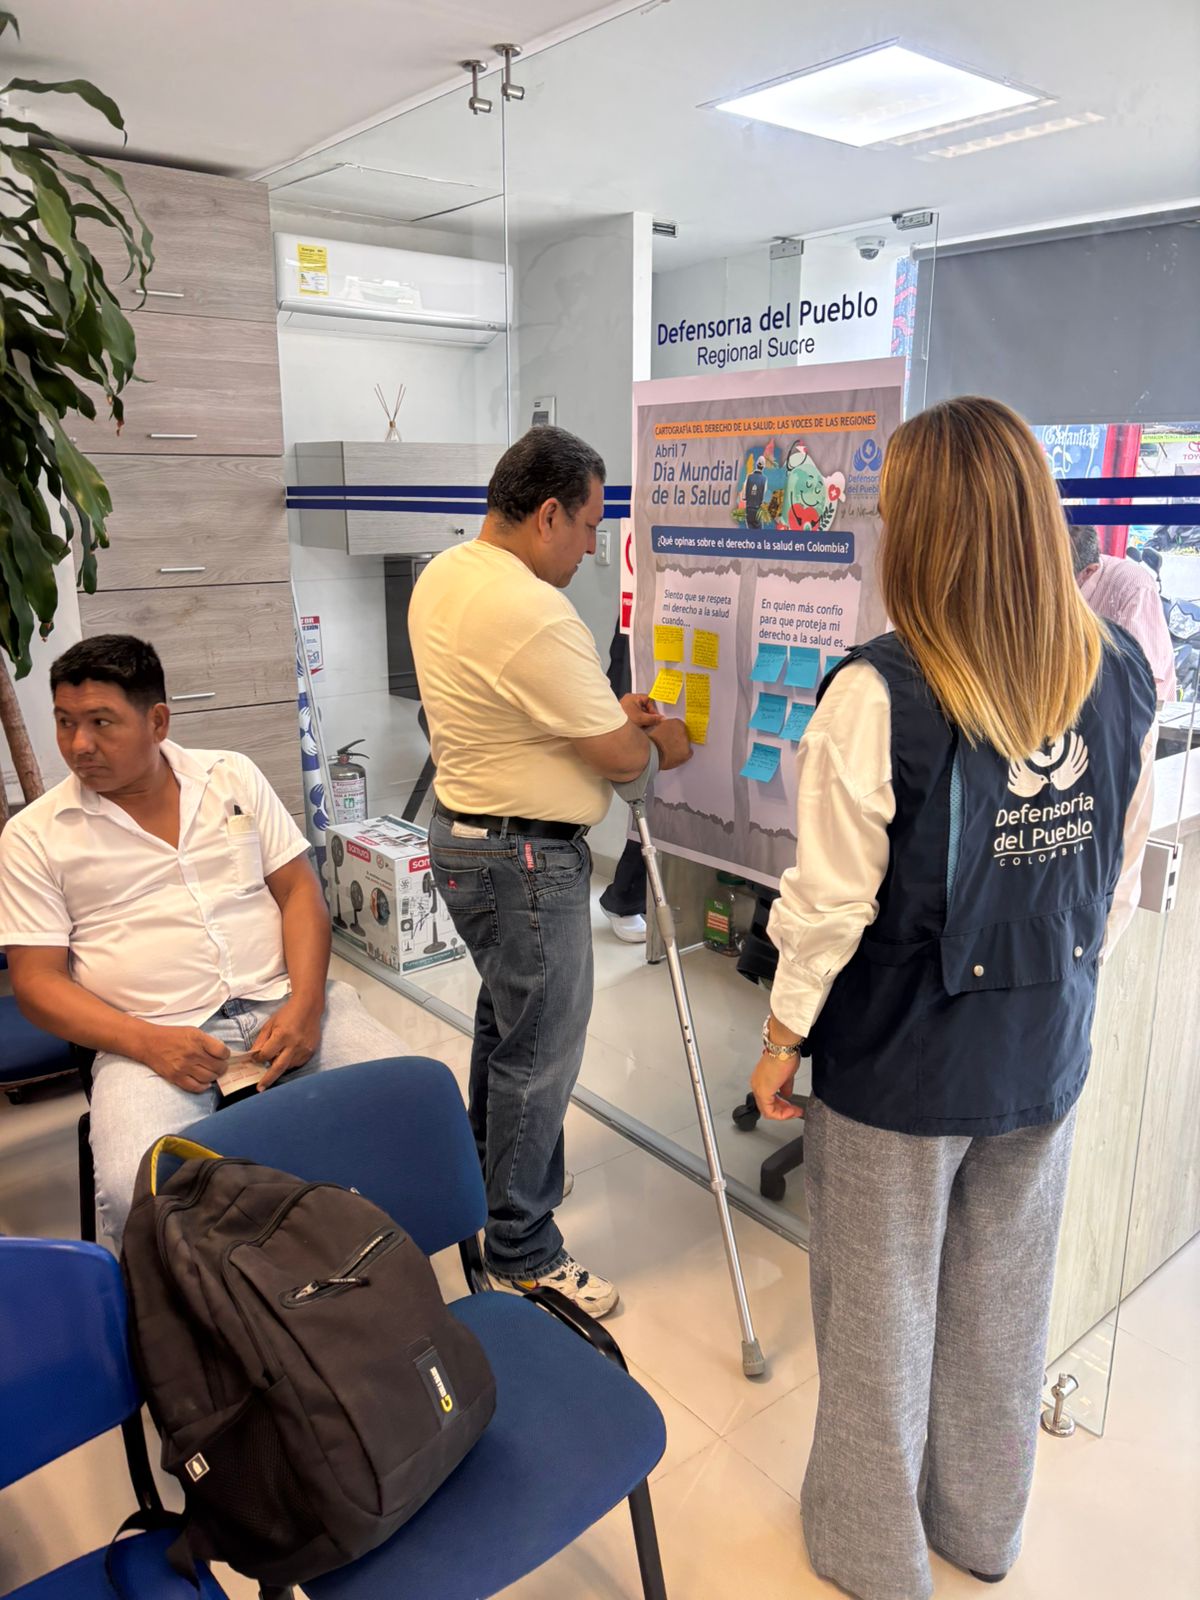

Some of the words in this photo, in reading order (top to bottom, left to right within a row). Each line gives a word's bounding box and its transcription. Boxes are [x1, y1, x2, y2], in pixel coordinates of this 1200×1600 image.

[759, 304, 791, 331] del
[800, 290, 878, 326] Pueblo
[697, 339, 762, 369] Regional
[767, 337, 815, 358] Sucre
[693, 424, 704, 433] DEL
[704, 422, 733, 433] DERECHO
[734, 422, 742, 432] DE
[743, 421, 752, 431] LA
[753, 420, 776, 431] SALUD:
[777, 419, 790, 430] LAS
[791, 418, 813, 429] VOCES
[814, 417, 824, 427] DE
[825, 416, 839, 427] LAS
[840, 414, 876, 426] REGIONES
[655, 443, 678, 458] Abril
[681, 443, 687, 457] 7
[1183, 453, 1200, 461] TOY
[653, 461, 675, 482] Día
[679, 460, 739, 482] Mundial
[652, 484, 669, 505] de
[673, 484, 685, 505] la
[690, 484, 732, 506] Salud
[674, 537, 696, 548] opinas
[697, 538, 715, 547] sobre
[717, 538, 725, 548] el
[726, 538, 755, 549] derecho
[764, 540, 771, 550] la
[772, 540, 793, 551] salud
[795, 543, 805, 551] en
[807, 542, 849, 554] Colombia?
[684, 592, 696, 602] que
[698, 594, 705, 602] se
[706, 595, 731, 606] respeta
[761, 599, 771, 609] En
[663, 603, 670, 611] mi
[671, 603, 697, 615] derecho
[704, 607, 710, 616] la
[711, 608, 730, 619] salud
[759, 615, 777, 626] para
[779, 617, 794, 627] que
[796, 618, 827, 632] proteja
[829, 621, 840, 631] mi
[758, 629, 791, 641] derecho
[800, 632, 807, 643] la
[809, 634, 832, 646] salud
[995, 792, 1095, 827] Defensoría
[993, 830, 1025, 852] del
[1032, 818, 1093, 848] Pueblo
